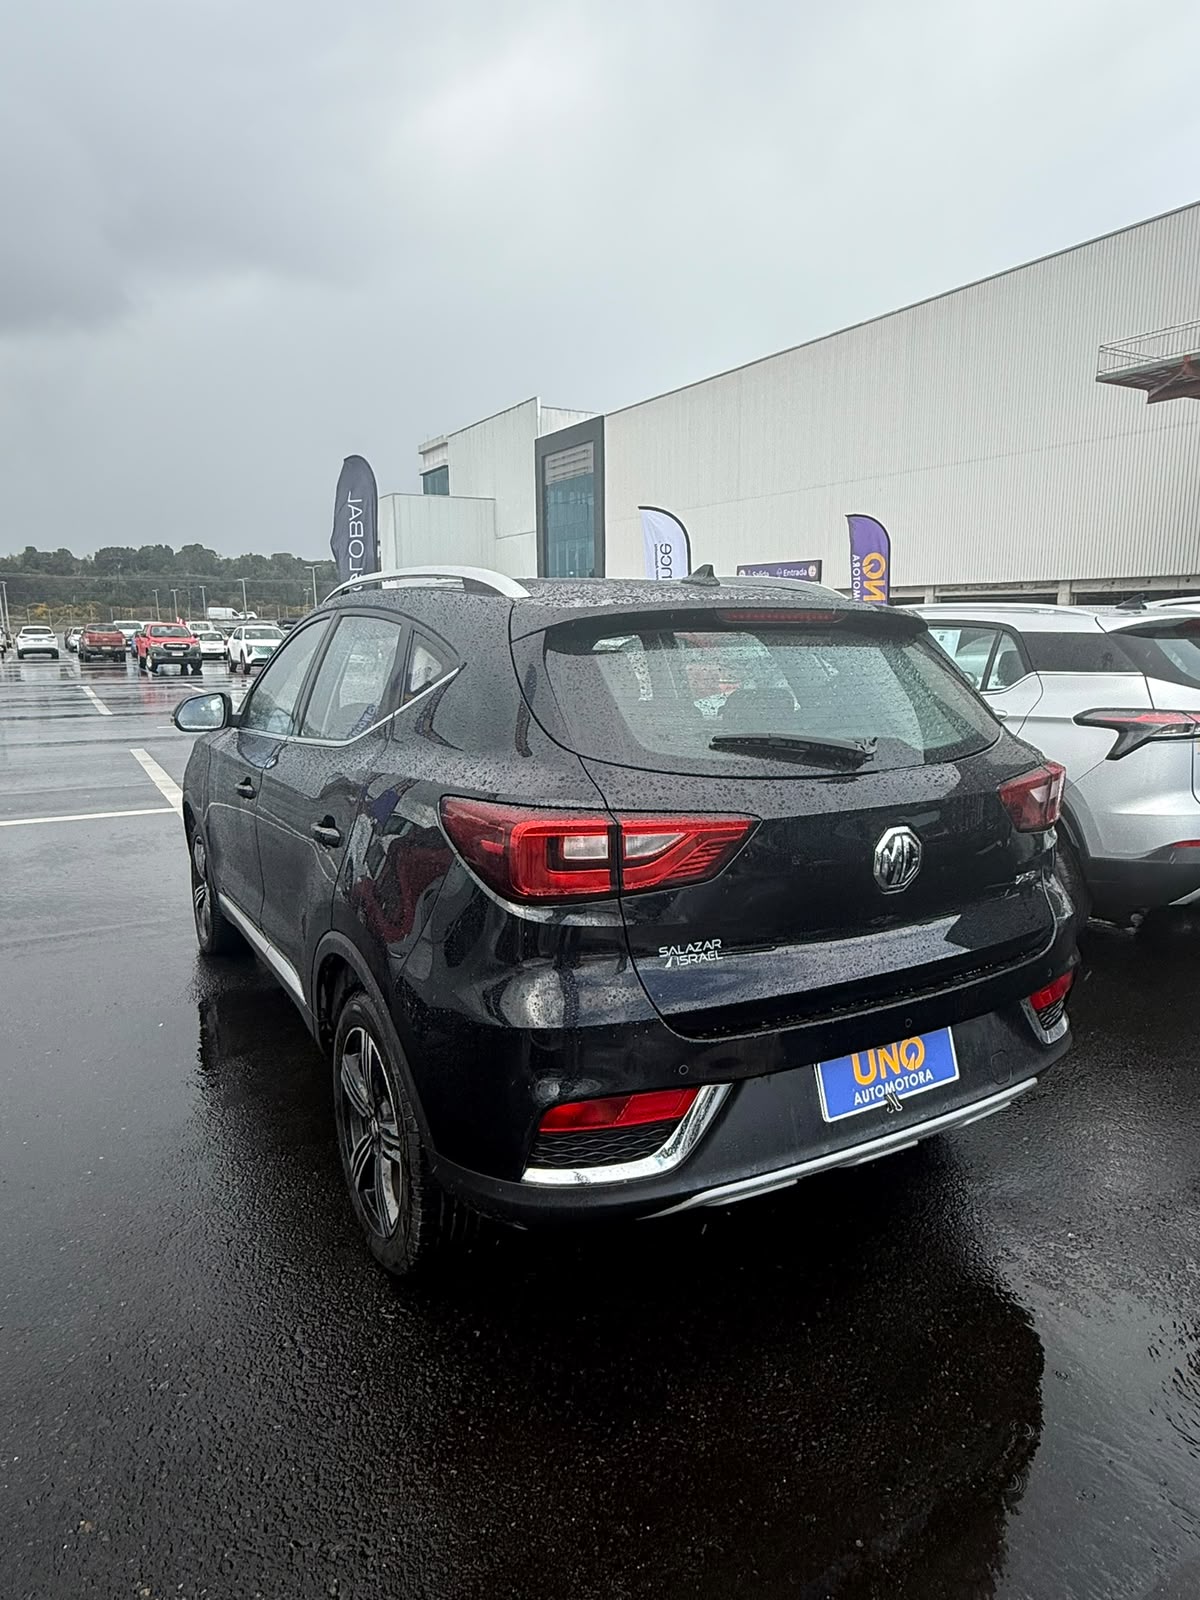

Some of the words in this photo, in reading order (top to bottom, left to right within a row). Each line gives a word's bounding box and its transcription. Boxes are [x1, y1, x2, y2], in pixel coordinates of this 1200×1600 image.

[783, 568, 807, 577] Entrada
[877, 830, 921, 890] MG
[658, 938, 722, 958] SALAZAR
[673, 950, 723, 967] ISRAEL
[851, 1036, 926, 1086] UNO
[854, 1069, 934, 1106] AUTOMOTORA
